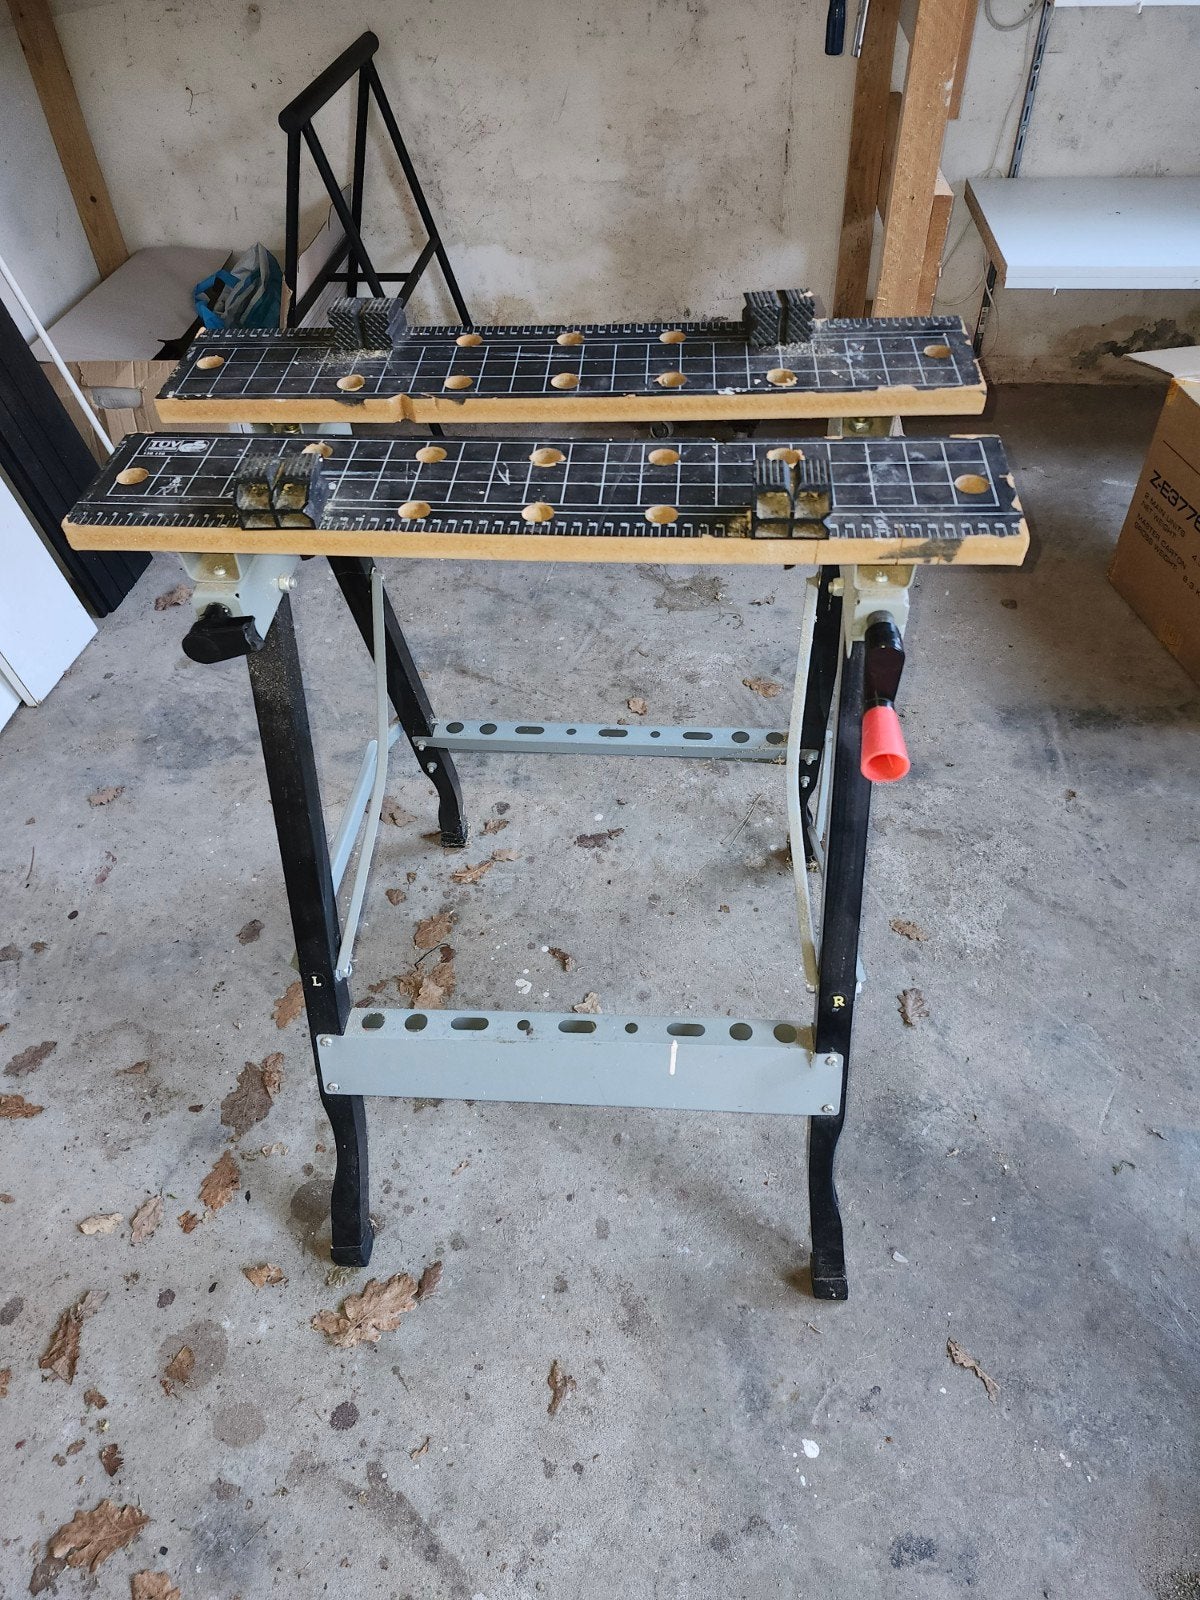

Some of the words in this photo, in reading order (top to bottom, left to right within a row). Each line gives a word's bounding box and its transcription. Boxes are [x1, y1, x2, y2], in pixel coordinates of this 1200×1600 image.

[1137, 512, 1161, 541] MASTER
[1160, 539, 1186, 570] CARTON
[311, 976, 322, 987] L
[832, 995, 845, 1007] R
